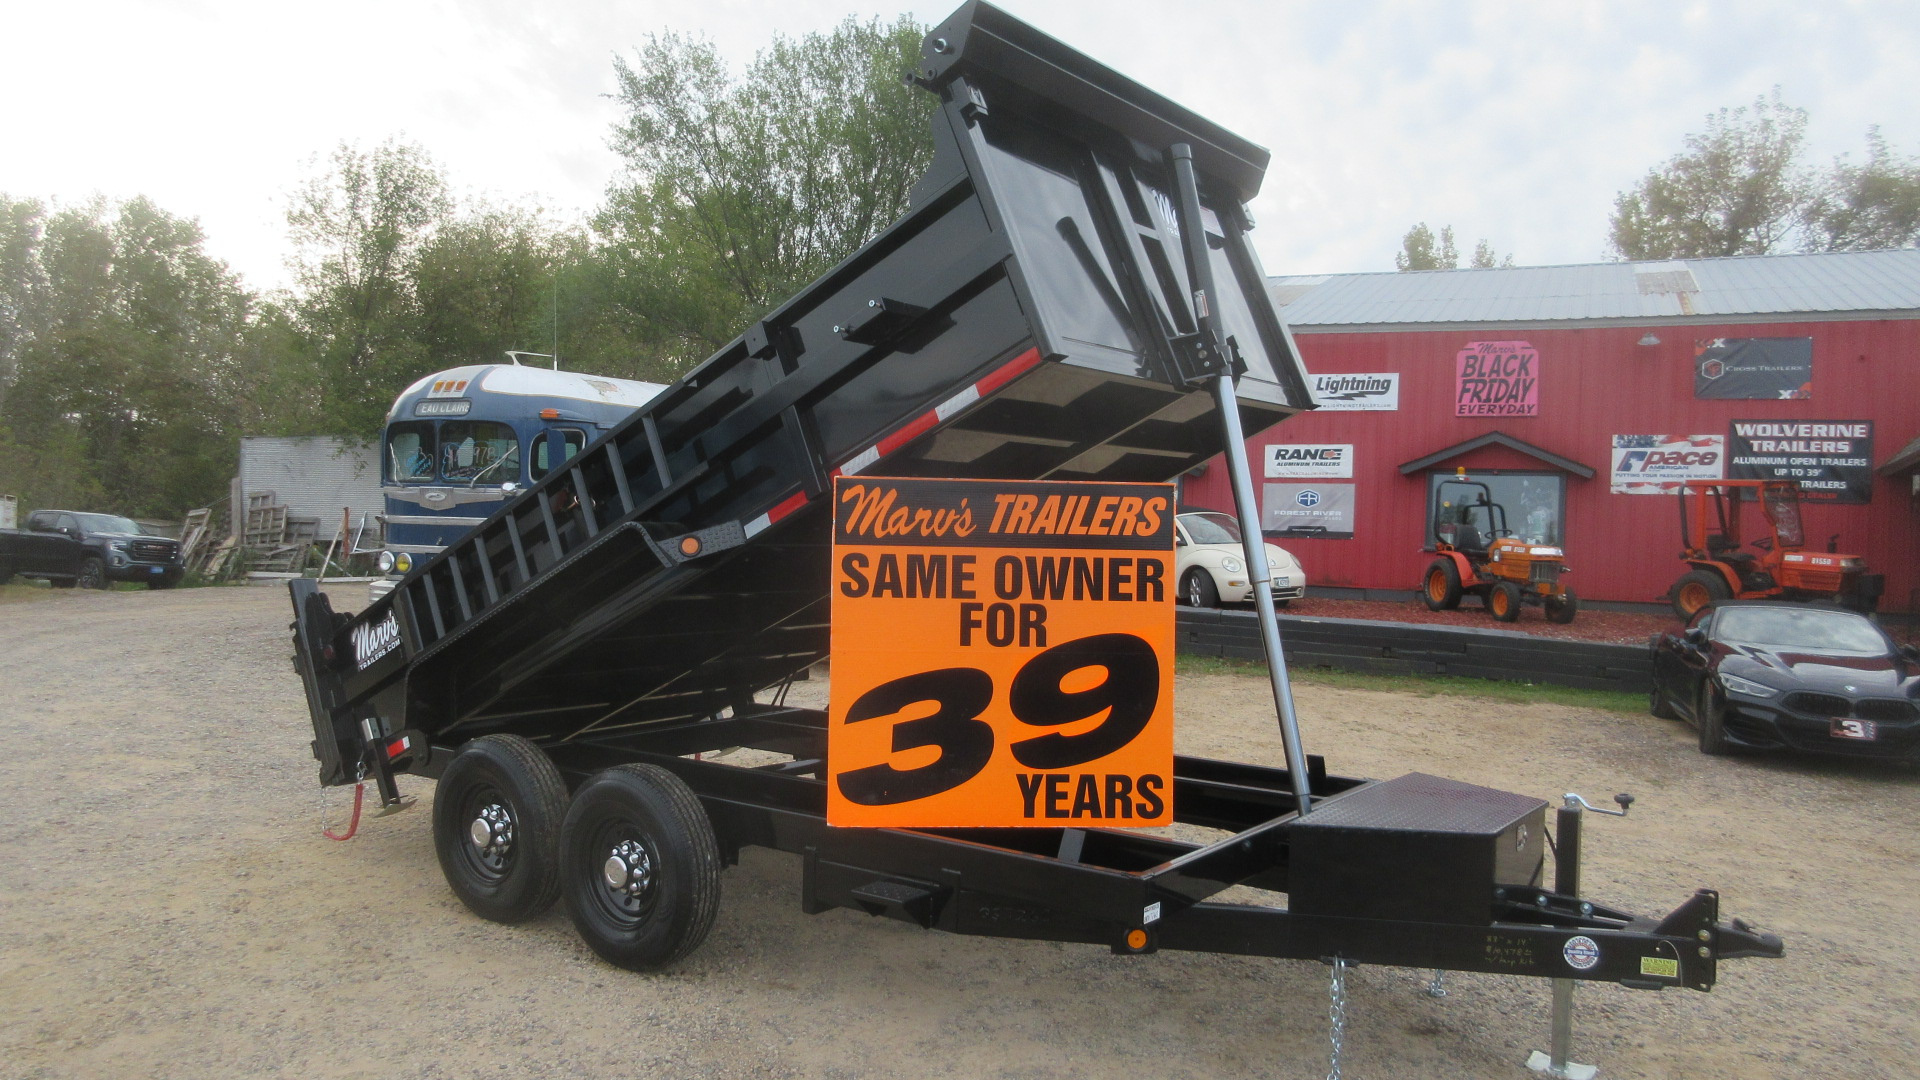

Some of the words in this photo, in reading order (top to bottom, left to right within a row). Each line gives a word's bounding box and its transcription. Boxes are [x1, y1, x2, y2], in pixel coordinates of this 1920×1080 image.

[1461, 354, 1534, 378] BLACK
[1316, 376, 1392, 395] Lightning
[1458, 378, 1536, 404] FRIDAY
[421, 403, 439, 413] EAU
[1457, 404, 1536, 415] EVERYDAY
[1735, 423, 1868, 438] WOLVERINE
[1750, 440, 1851, 453] TRAILERS
[1640, 450, 1719, 472] pace
[1733, 456, 1787, 465] ALUMINUM
[1790, 457, 1817, 466] OPEN
[1820, 458, 1867, 467] TRAILERS
[1774, 468, 1788, 476] UP
[1791, 468, 1804, 477] TO
[1800, 480, 1847, 490] TRAILERS
[841, 484, 977, 539] Marv's
[988, 494, 1167, 537] TRAILERS
[840, 553, 977, 600] SAME
[994, 556, 1165, 602] OWNER
[352, 609, 399, 661] Marv's
[959, 602, 1048, 648] FOR
[359, 638, 401, 671] TRAILERS.COM
[836, 632, 1160, 807] 39
[1842, 720, 1864, 737] 3
[1016, 773, 1165, 819] YEARS
